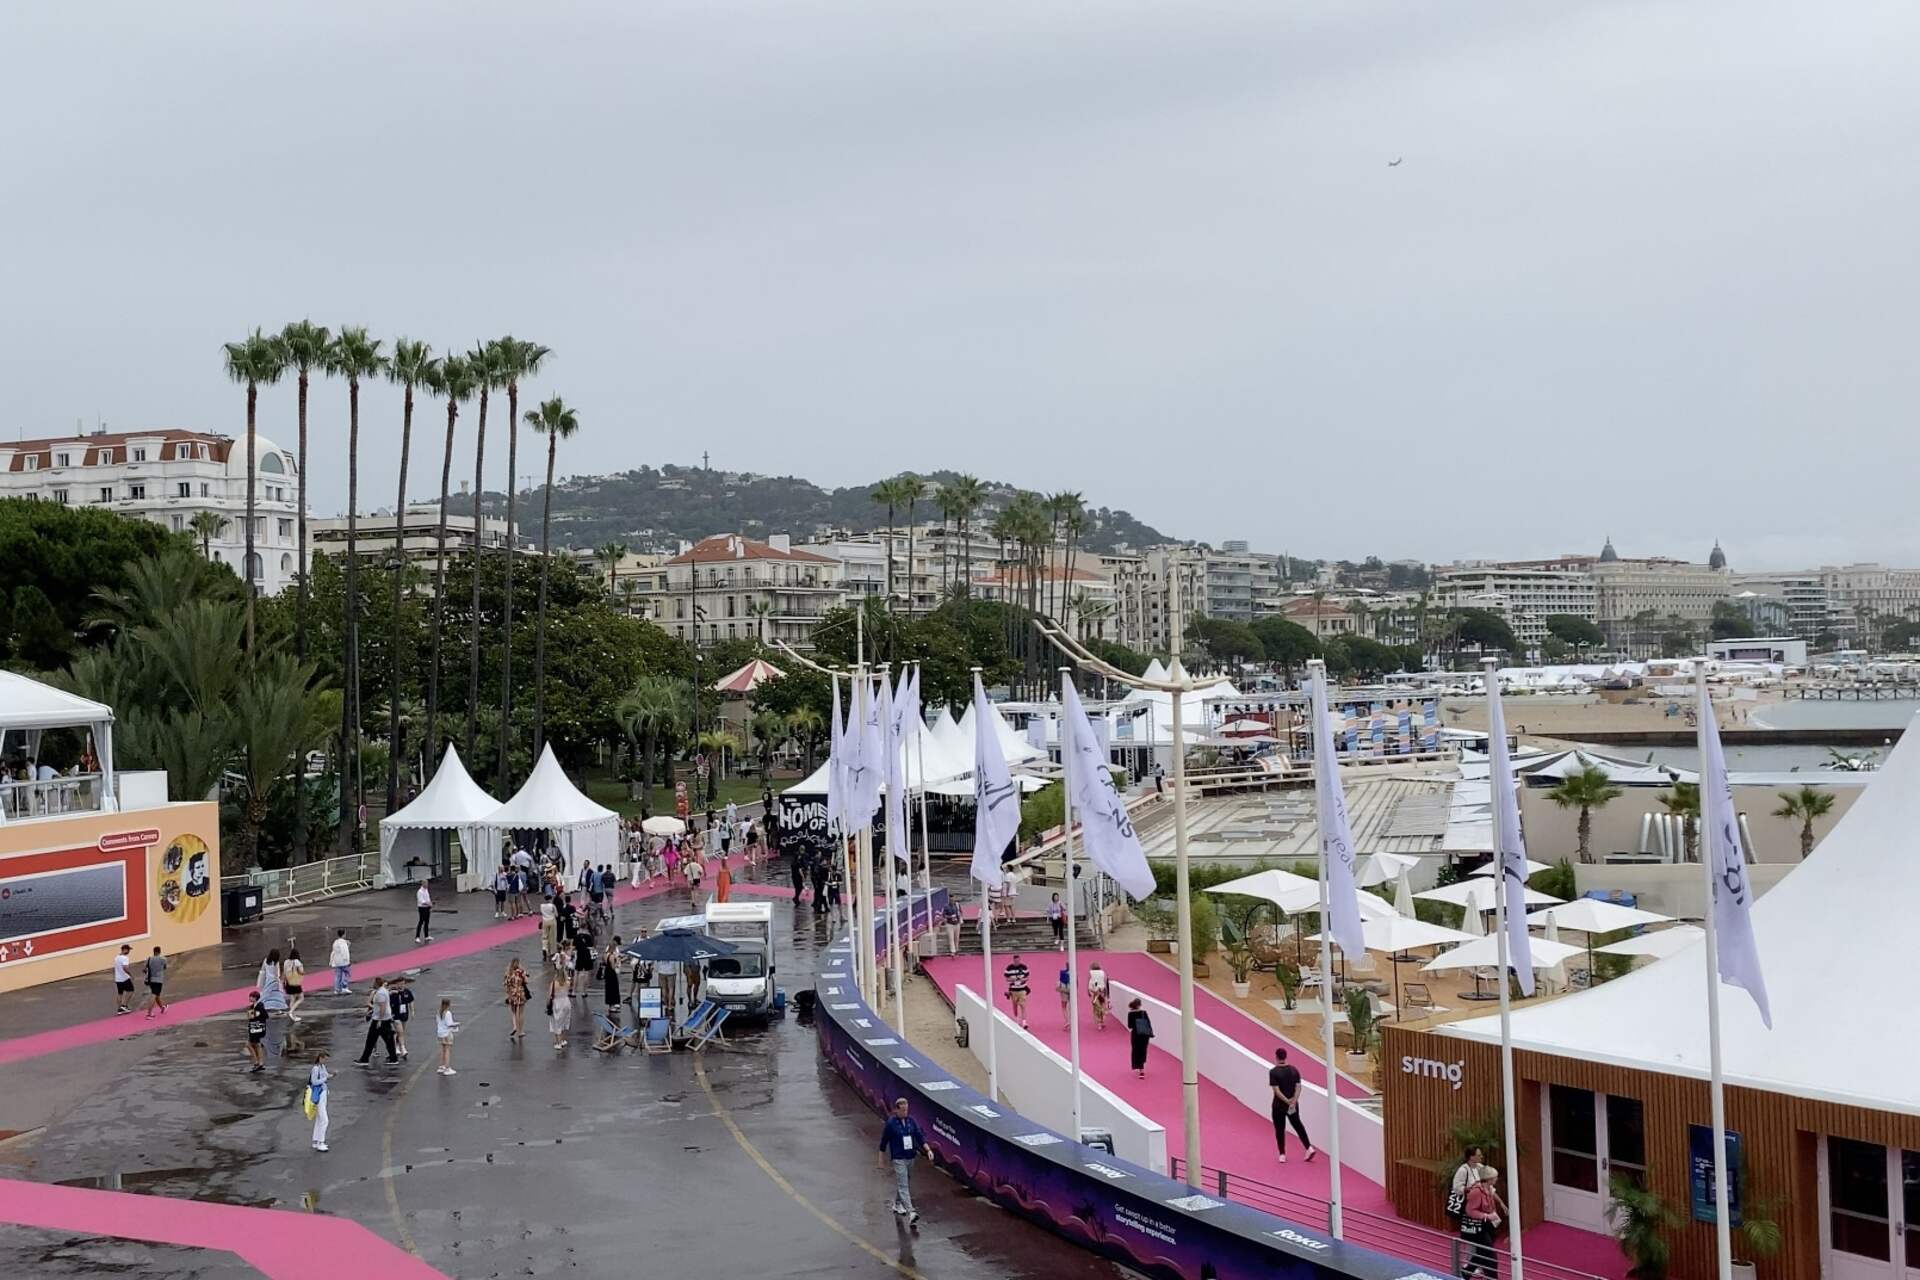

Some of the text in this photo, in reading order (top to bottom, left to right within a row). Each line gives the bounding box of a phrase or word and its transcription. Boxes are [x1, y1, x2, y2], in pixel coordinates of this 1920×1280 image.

[780, 802, 828, 830] HOME
[810, 818, 826, 830] OF
[1402, 1056, 1465, 1090] srmg
[1115, 1214, 1146, 1233] storytelling
[1159, 1221, 1177, 1234] better
